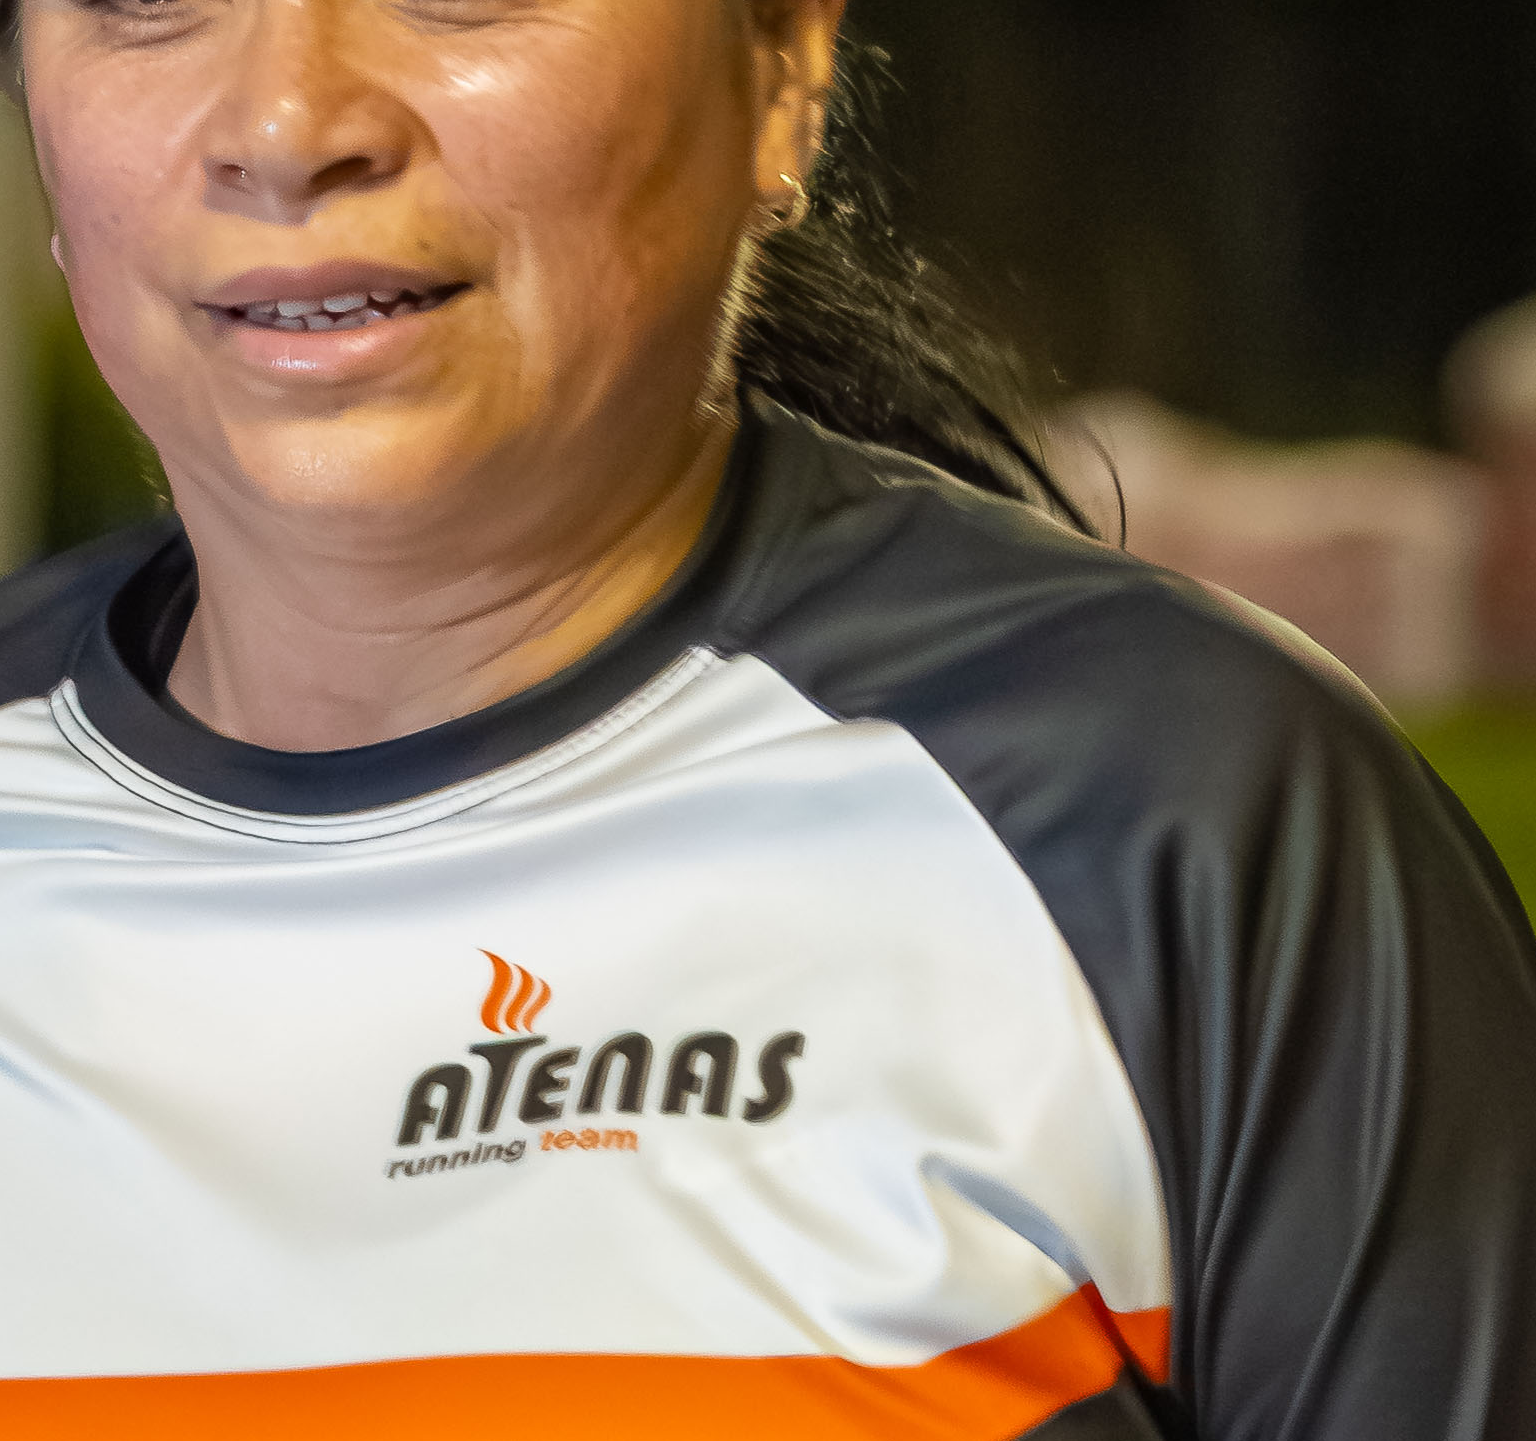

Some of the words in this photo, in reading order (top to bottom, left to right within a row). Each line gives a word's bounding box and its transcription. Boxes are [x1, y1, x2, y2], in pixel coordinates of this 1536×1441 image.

[397, 1030, 807, 1146] ATENAS
[386, 1139, 527, 1179] running
[540, 1128, 639, 1154] team
